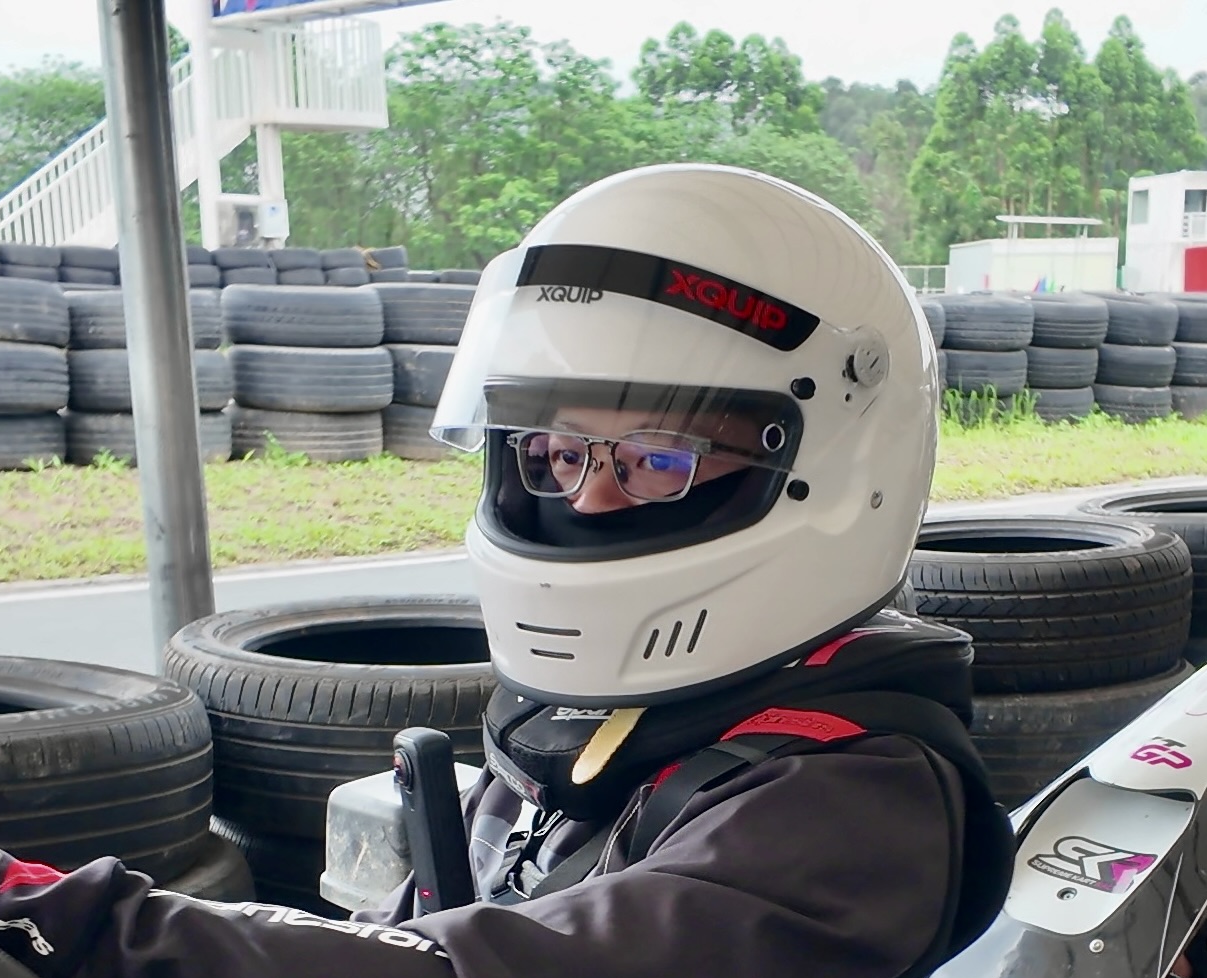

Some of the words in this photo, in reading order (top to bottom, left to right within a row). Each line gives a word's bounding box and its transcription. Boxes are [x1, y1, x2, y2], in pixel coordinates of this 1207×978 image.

[536, 286, 604, 304] XQUIP
[664, 269, 789, 331] XQUIP
[1031, 859, 1073, 881] SUPREME
[1072, 874, 1096, 886] KART
